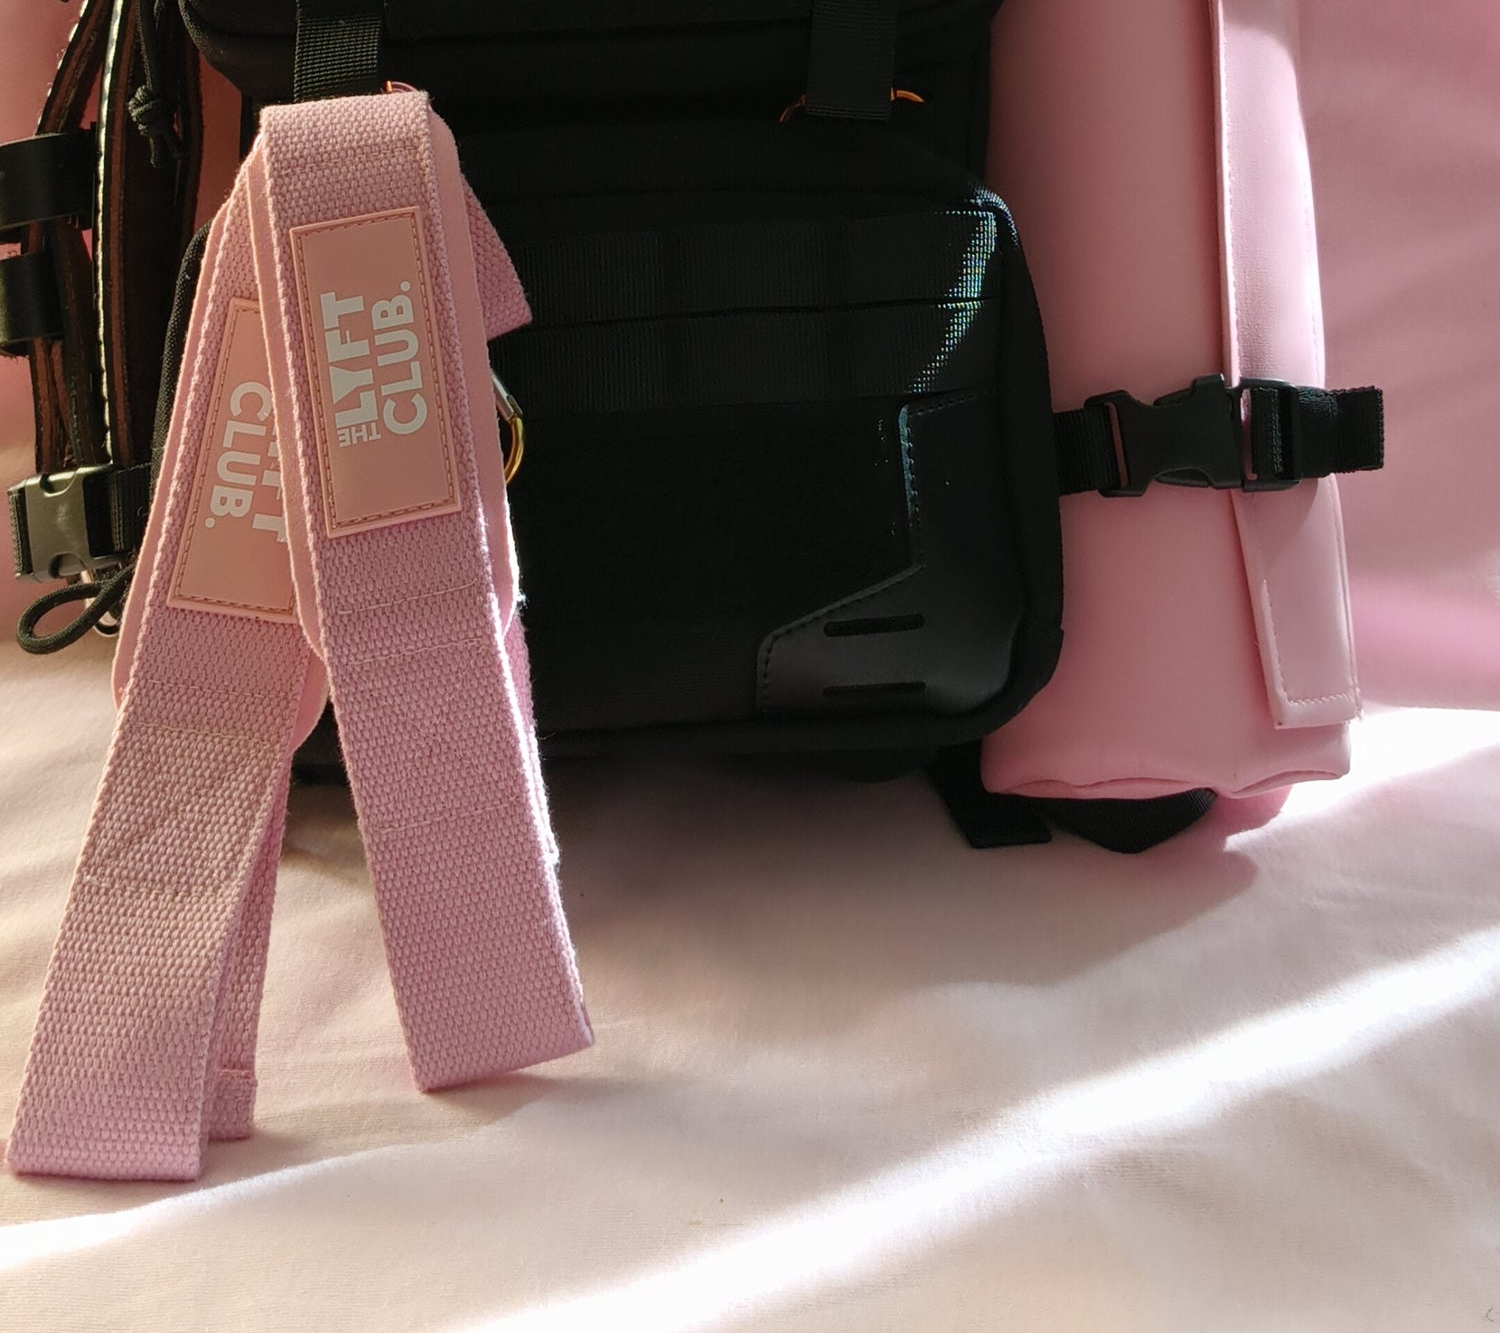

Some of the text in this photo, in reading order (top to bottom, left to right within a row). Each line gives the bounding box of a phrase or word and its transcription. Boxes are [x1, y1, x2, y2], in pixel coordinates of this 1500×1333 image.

[320, 291, 379, 429] LYFT
[371, 281, 428, 435] CLUB.
[204, 381, 273, 530] CLUB.
[337, 421, 382, 448] THE
